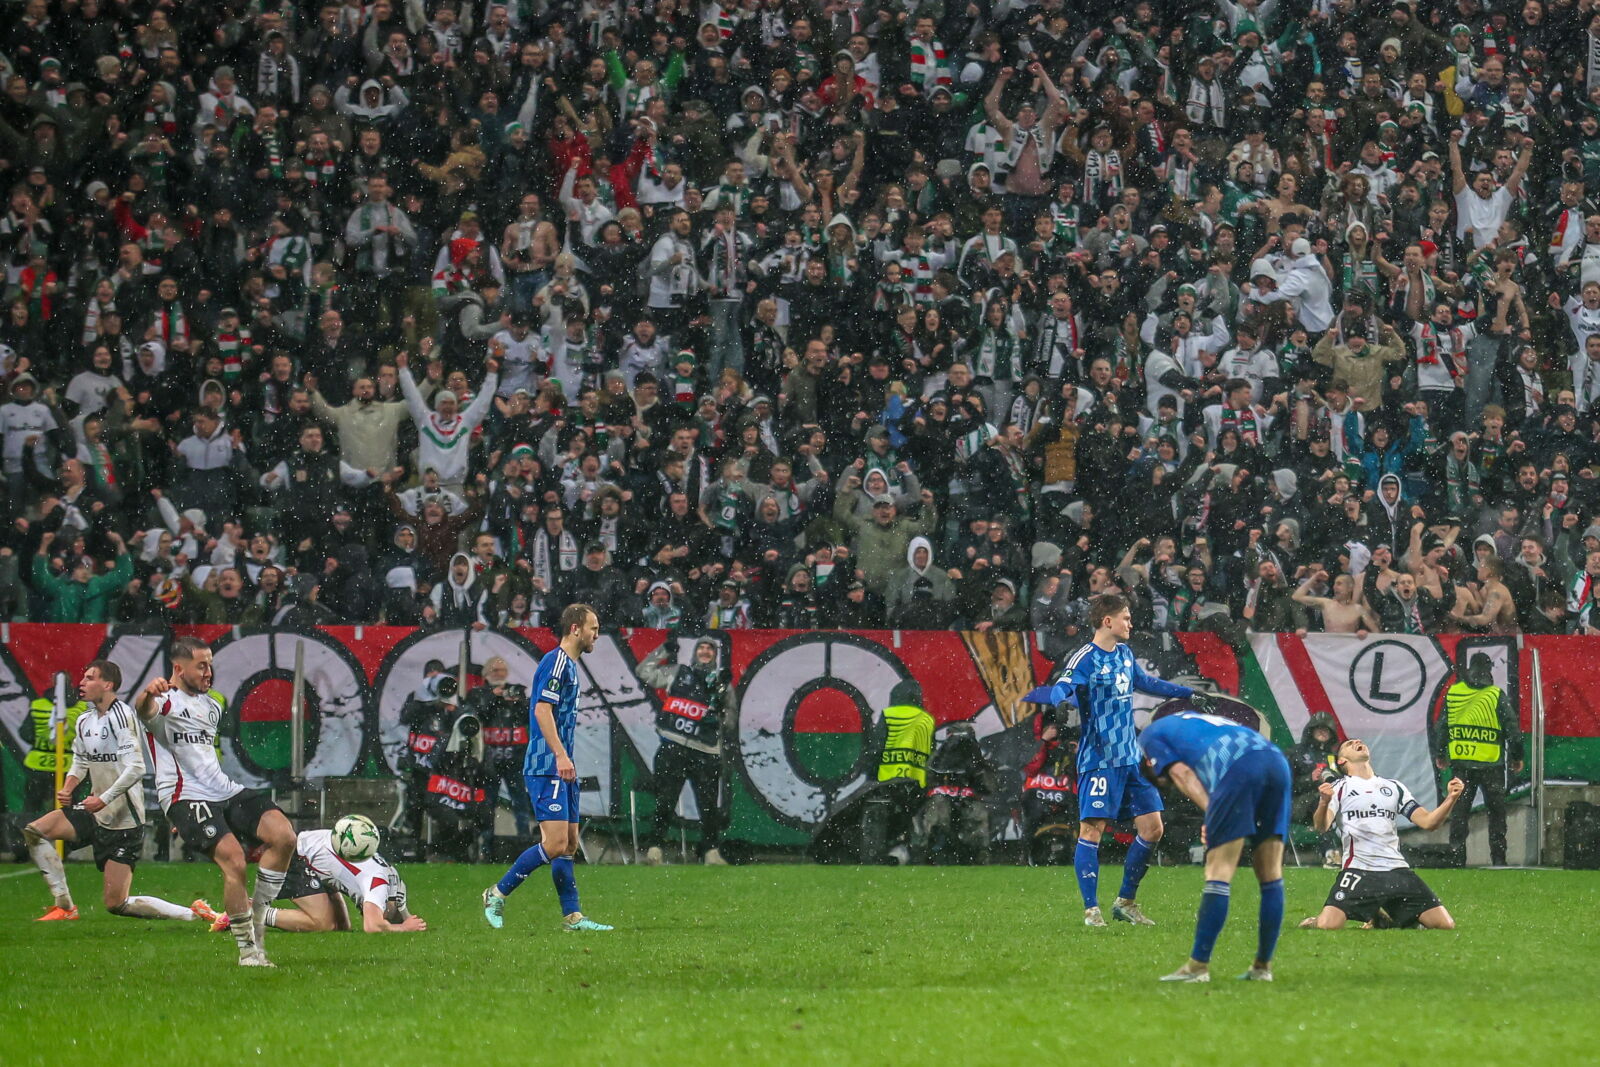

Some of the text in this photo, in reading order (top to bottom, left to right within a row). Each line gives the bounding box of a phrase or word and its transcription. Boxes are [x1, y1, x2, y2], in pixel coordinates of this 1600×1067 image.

[1369, 651, 1401, 703] L
[1454, 744, 1477, 756] 037
[551, 780, 560, 799] 7
[1090, 777, 1107, 796] 29
[190, 801, 213, 824] 21
[1347, 808, 1396, 821] Plus500
[1339, 871, 1362, 891] 67
